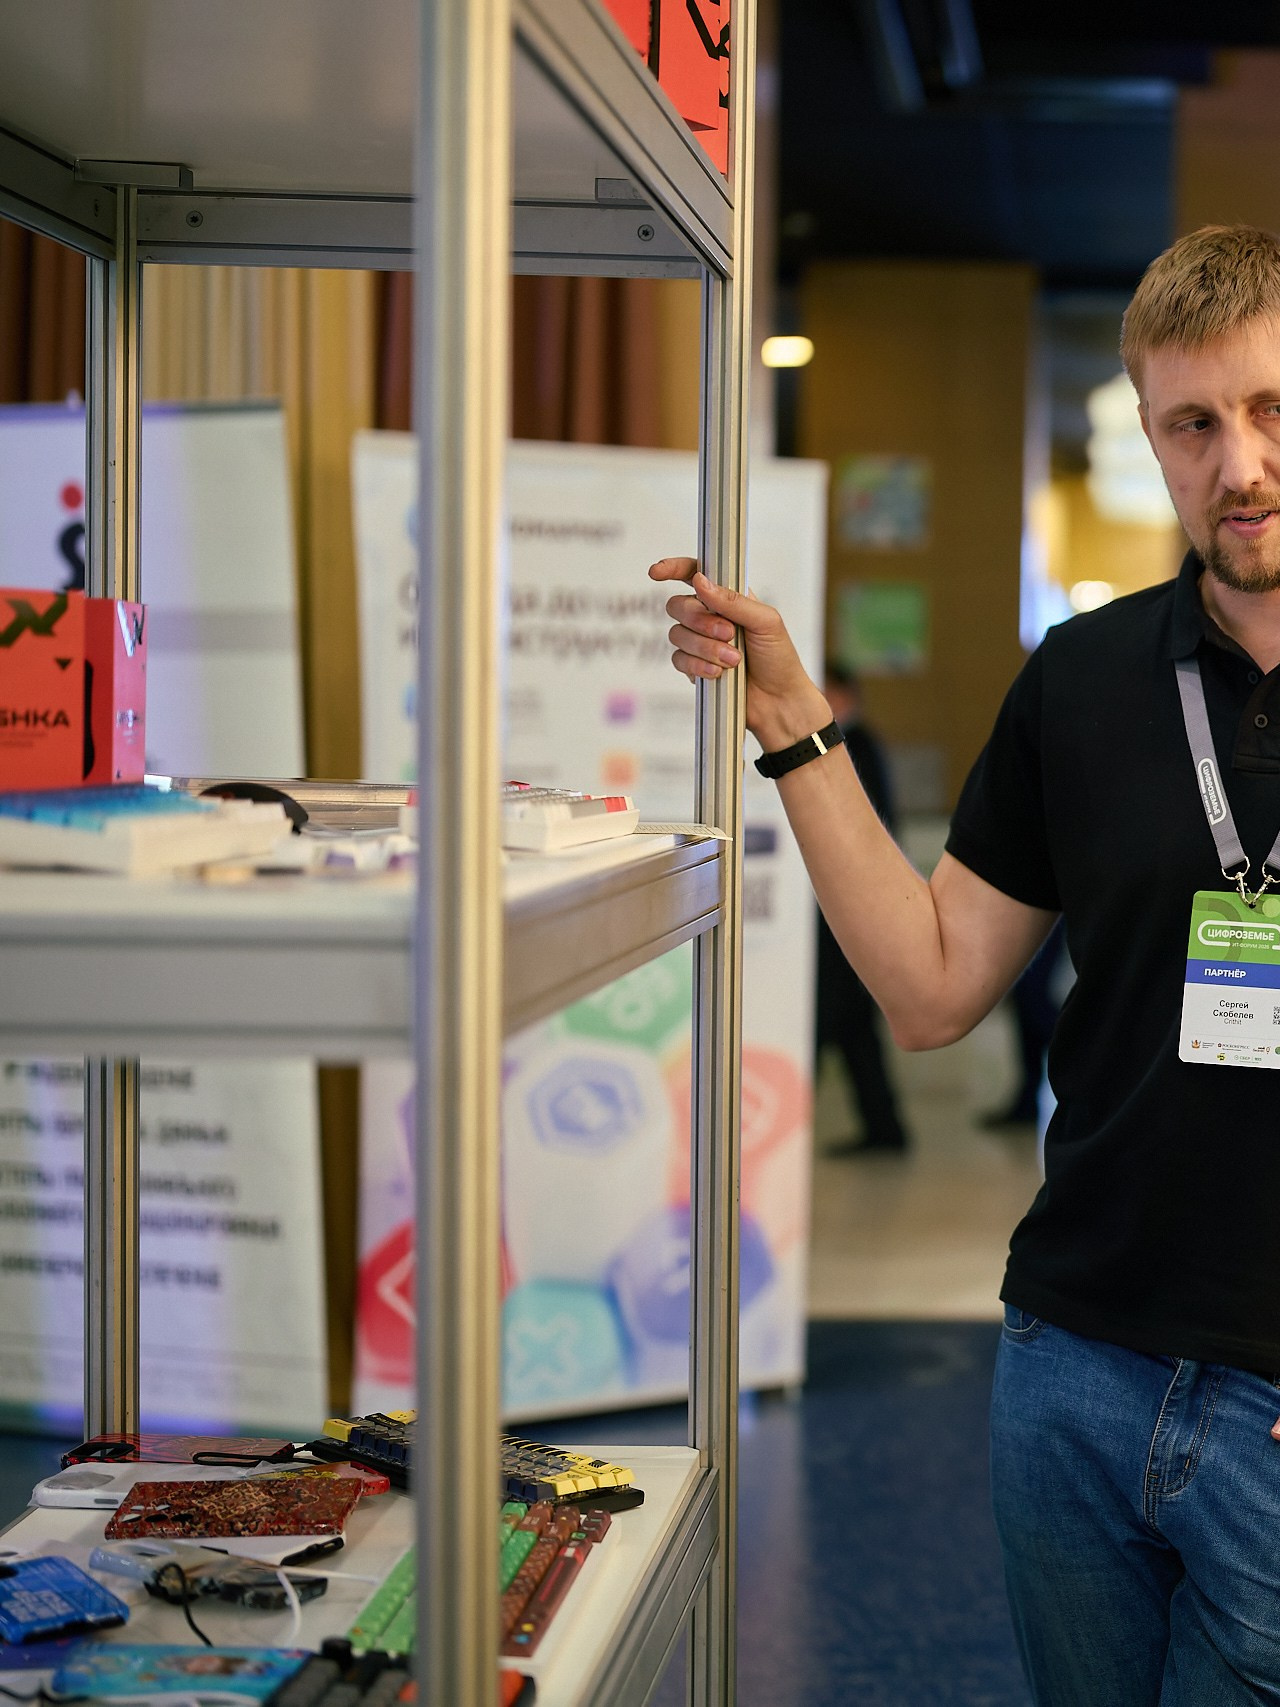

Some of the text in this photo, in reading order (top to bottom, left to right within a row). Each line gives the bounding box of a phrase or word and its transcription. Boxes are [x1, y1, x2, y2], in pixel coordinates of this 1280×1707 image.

[1203, 765, 1221, 815] ЦИФРОЗЕМЬЕ
[1207, 928, 1275, 941] ЦИФРОЗЕМЬЕ
[1204, 968, 1246, 978] ПАРТНЁР
[1219, 1000, 1249, 1009] Сергей
[1213, 1010, 1254, 1019] Скобелев
